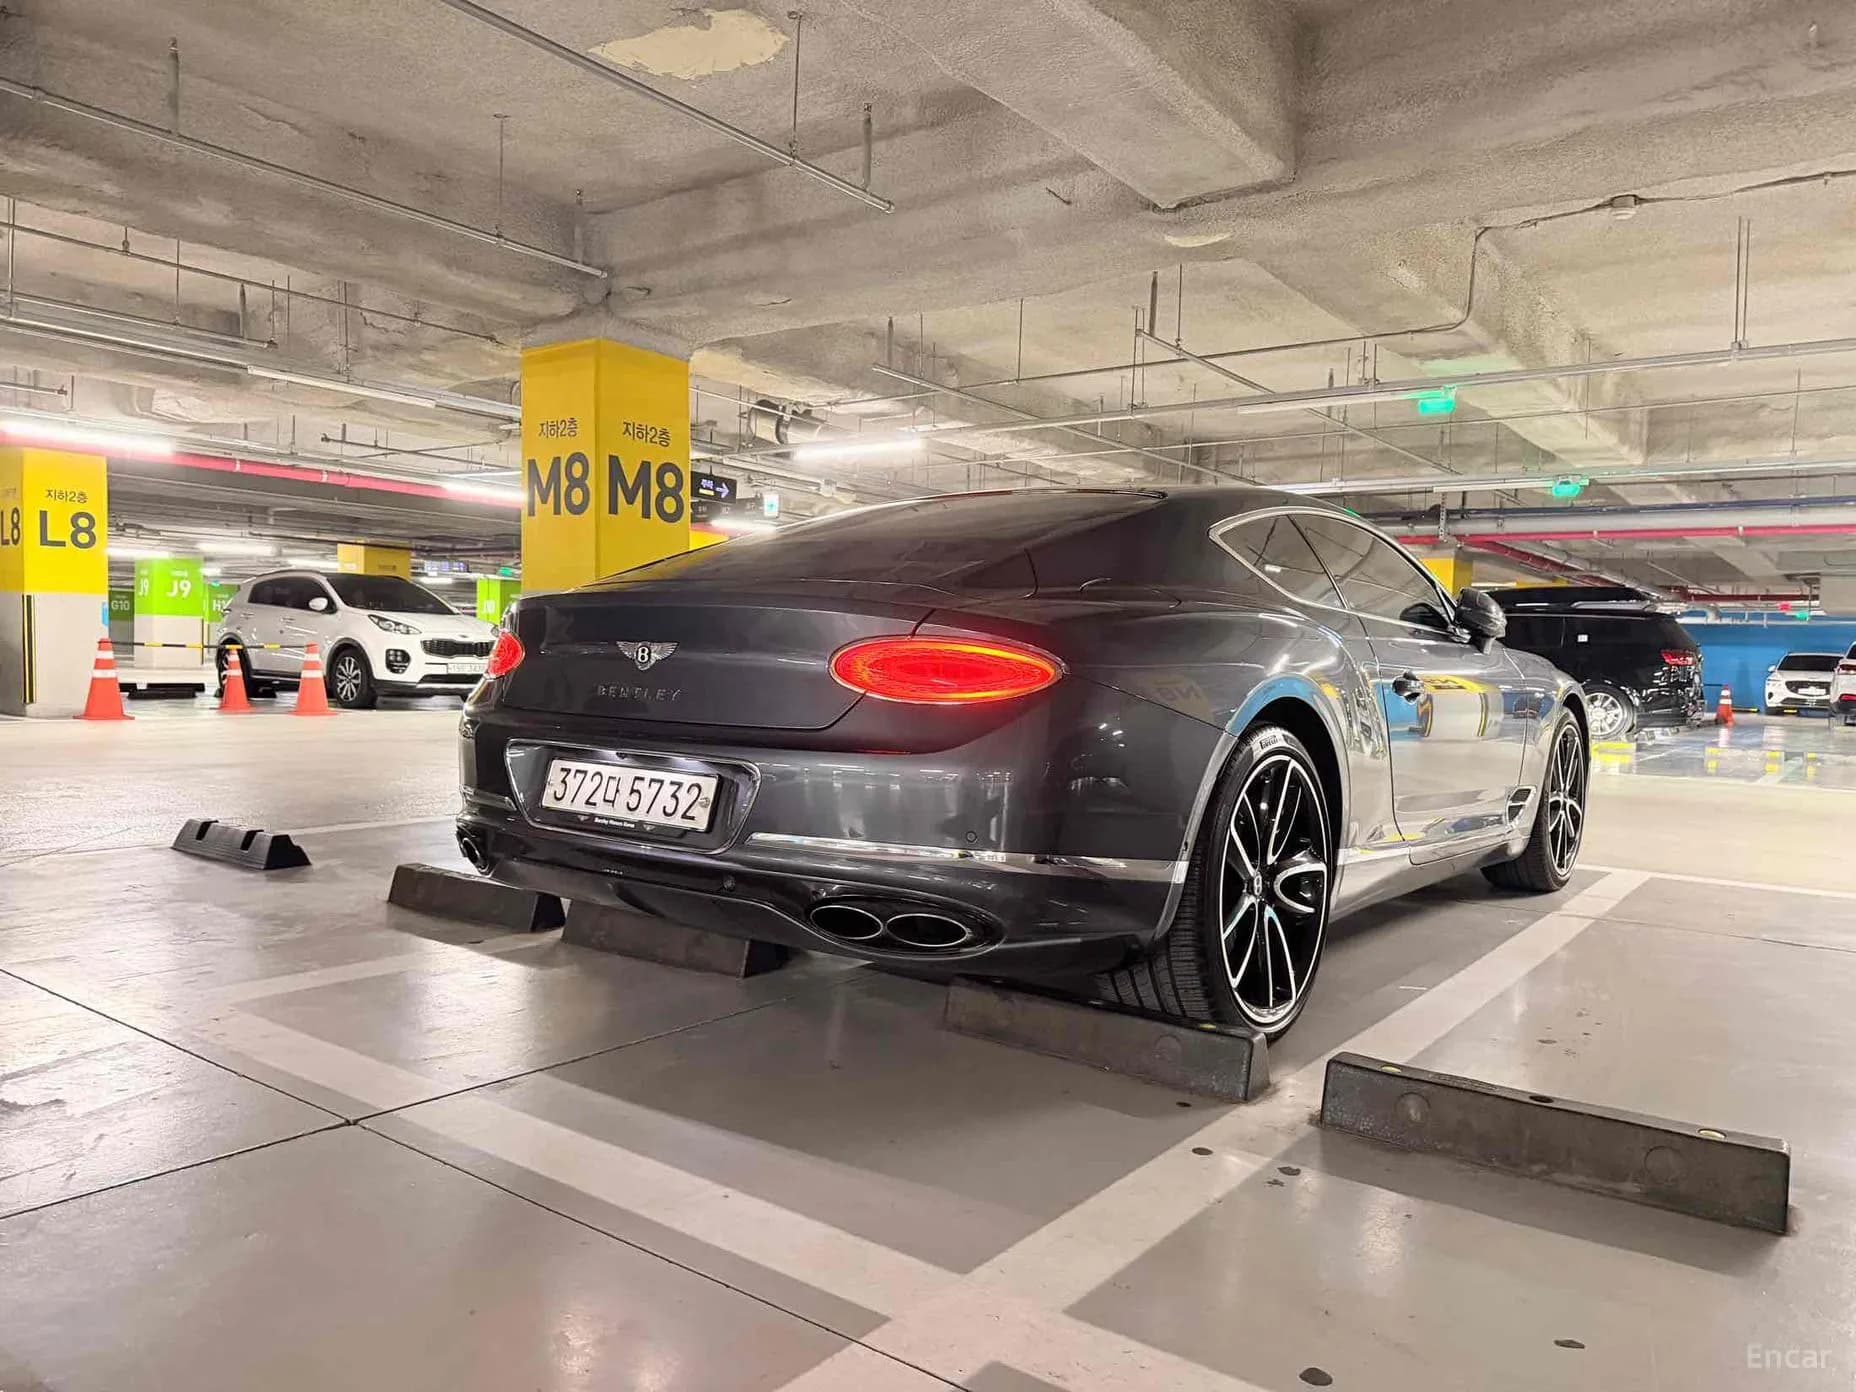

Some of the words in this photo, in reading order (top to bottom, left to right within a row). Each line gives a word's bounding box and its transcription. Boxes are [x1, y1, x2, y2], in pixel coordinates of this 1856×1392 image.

[538, 418, 578, 438] 지하2층
[622, 421, 671, 447] 지하2층
[45, 489, 88, 504] 지하2층
[527, 451, 590, 516] M8
[608, 454, 685, 523] M8
[0, 507, 20, 546] L8
[39, 510, 97, 549] L8
[166, 580, 192, 598] J9
[110, 600, 130, 611] G10
[597, 685, 681, 701] BENTLEY
[554, 767, 621, 808] 372다
[626, 776, 702, 821] 5732
